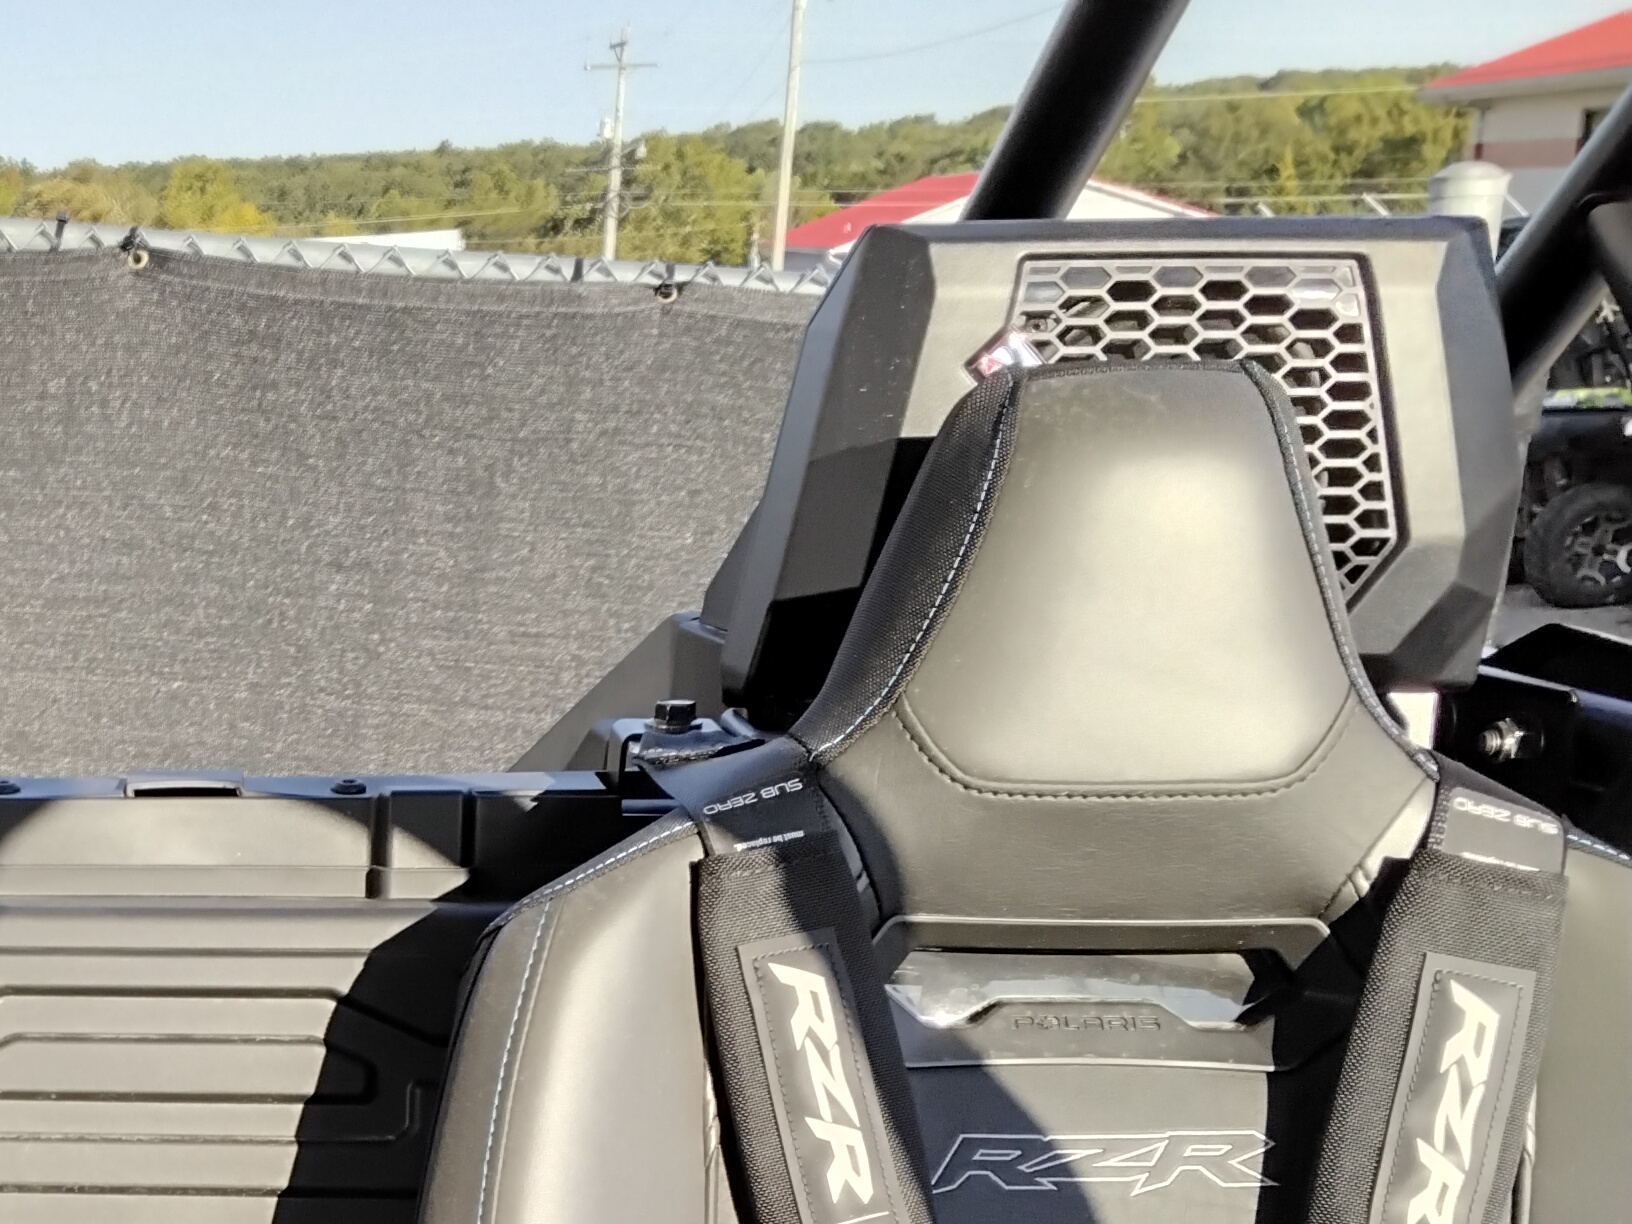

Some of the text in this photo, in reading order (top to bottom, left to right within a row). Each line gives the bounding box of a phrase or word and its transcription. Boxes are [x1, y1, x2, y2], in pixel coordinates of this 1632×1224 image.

[703, 778, 803, 815] SUB ZERO
[1453, 797, 1559, 834] SUB ZERO
[1011, 1014, 1161, 1031] POLARIS
[768, 963, 874, 1204] RZR
[931, 1130, 1279, 1196] RZR
